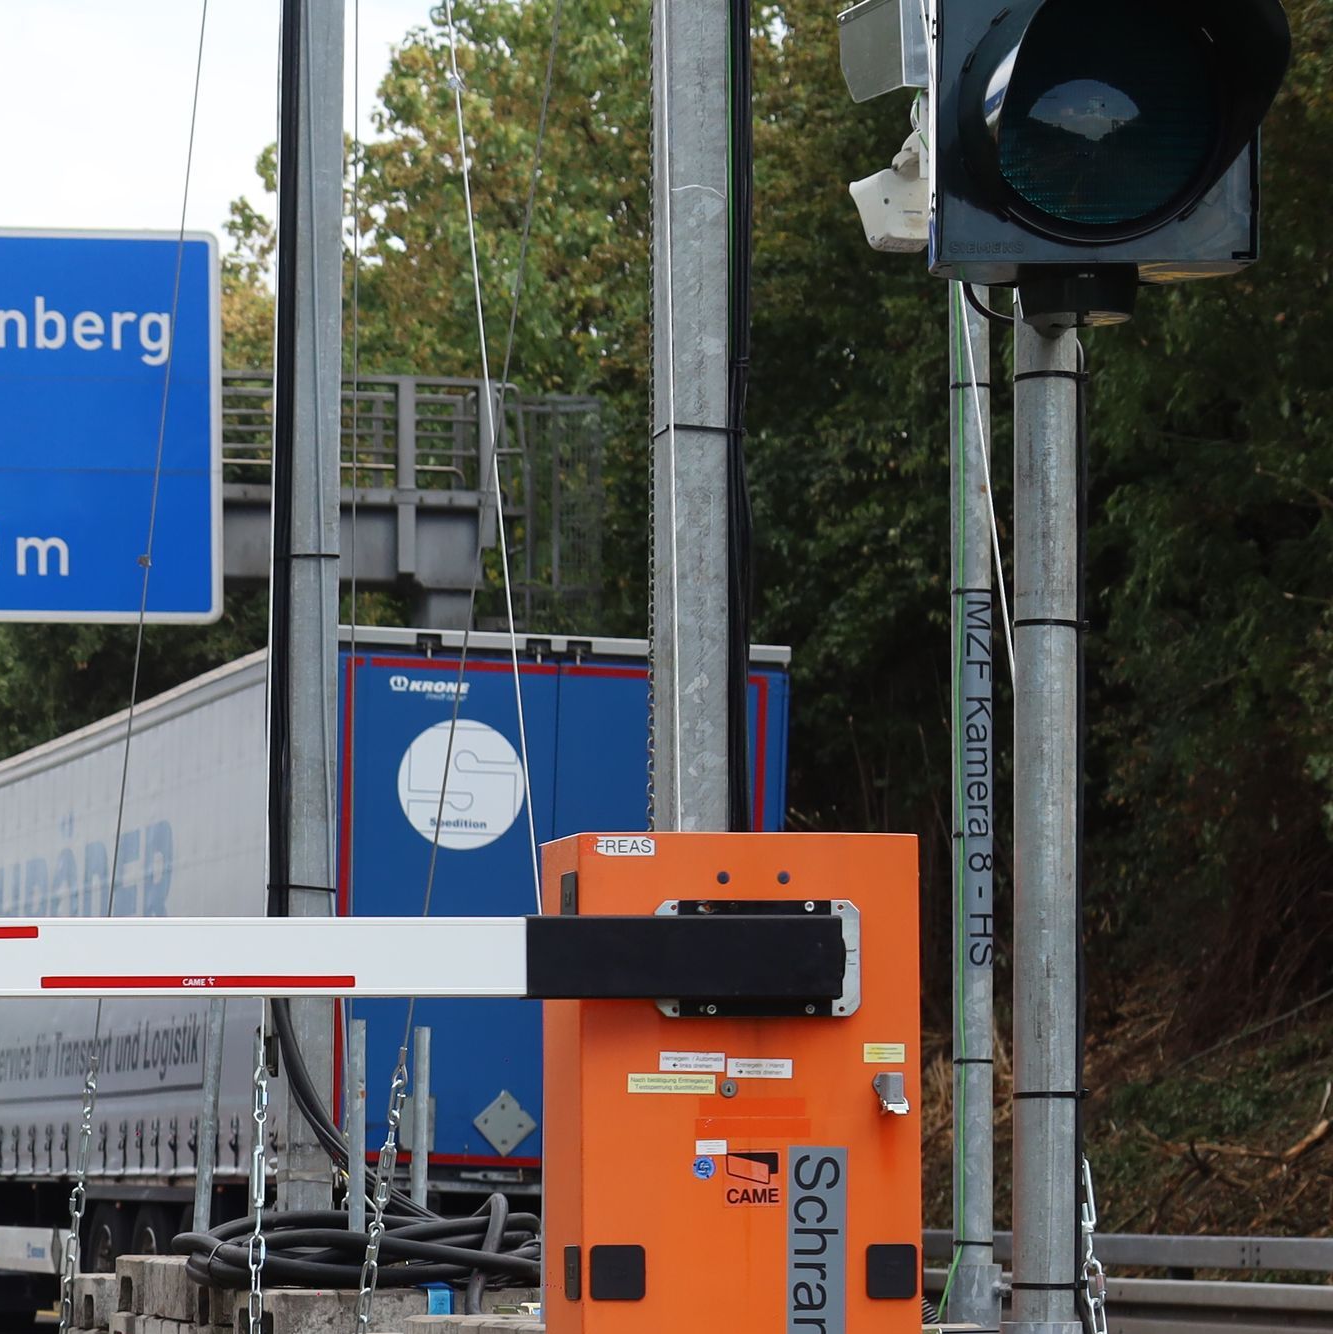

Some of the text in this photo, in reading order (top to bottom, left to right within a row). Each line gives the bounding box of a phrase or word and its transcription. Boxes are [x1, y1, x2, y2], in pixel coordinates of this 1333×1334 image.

[16, 534, 71, 576] m
[966, 600, 992, 682] MZF
[409, 680, 470, 694] KRONE
[966, 696, 993, 838] Kamera
[968, 851, 993, 873] 8
[969, 913, 993, 967] HS
[181, 978, 206, 986] CAME
[114, 1021, 141, 1073] und
[142, 1013, 201, 1081] Logistik
[726, 1188, 780, 1204] CAME
